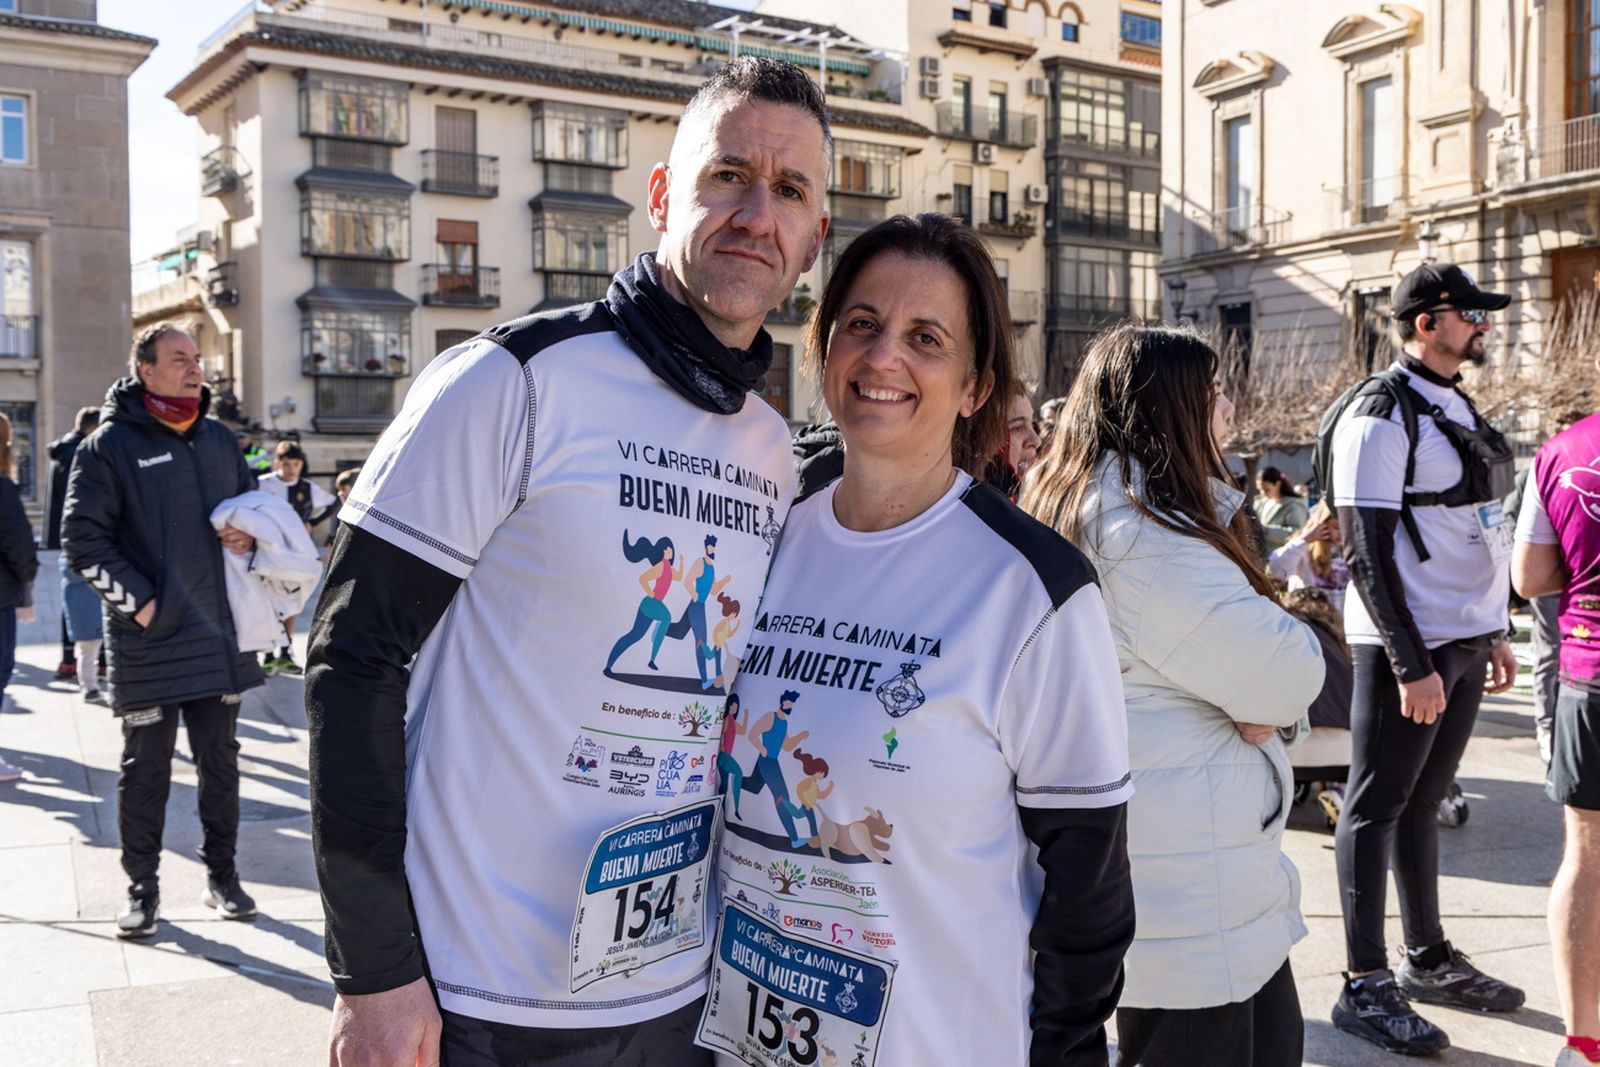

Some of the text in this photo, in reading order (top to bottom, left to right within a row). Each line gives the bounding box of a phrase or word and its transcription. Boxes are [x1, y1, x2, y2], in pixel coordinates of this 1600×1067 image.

[618, 439, 779, 501] VI CARRERA CAMINATA
[619, 473, 760, 537] BUENA MUERTE
[832, 621, 942, 658] CAMINATA
[776, 648, 882, 693] MUERTE
[601, 702, 615, 712] En
[618, 704, 660, 719] beneficio
[607, 786, 646, 797] AURINGIS
[609, 769, 650, 784] BYD
[618, 827, 663, 848] CARRERA
[664, 813, 702, 838] CAMINATA
[599, 841, 684, 883] BUENA MUERTE
[810, 876, 877, 897] ASPERGER-TEA
[857, 898, 880, 909] Jaén
[613, 873, 679, 943] 154
[736, 917, 864, 983] VI CARRERA CAMINATA
[862, 934, 897, 946] VICTORIA
[731, 939, 829, 1003] BUENA MUERTE
[746, 981, 820, 1066] 153
